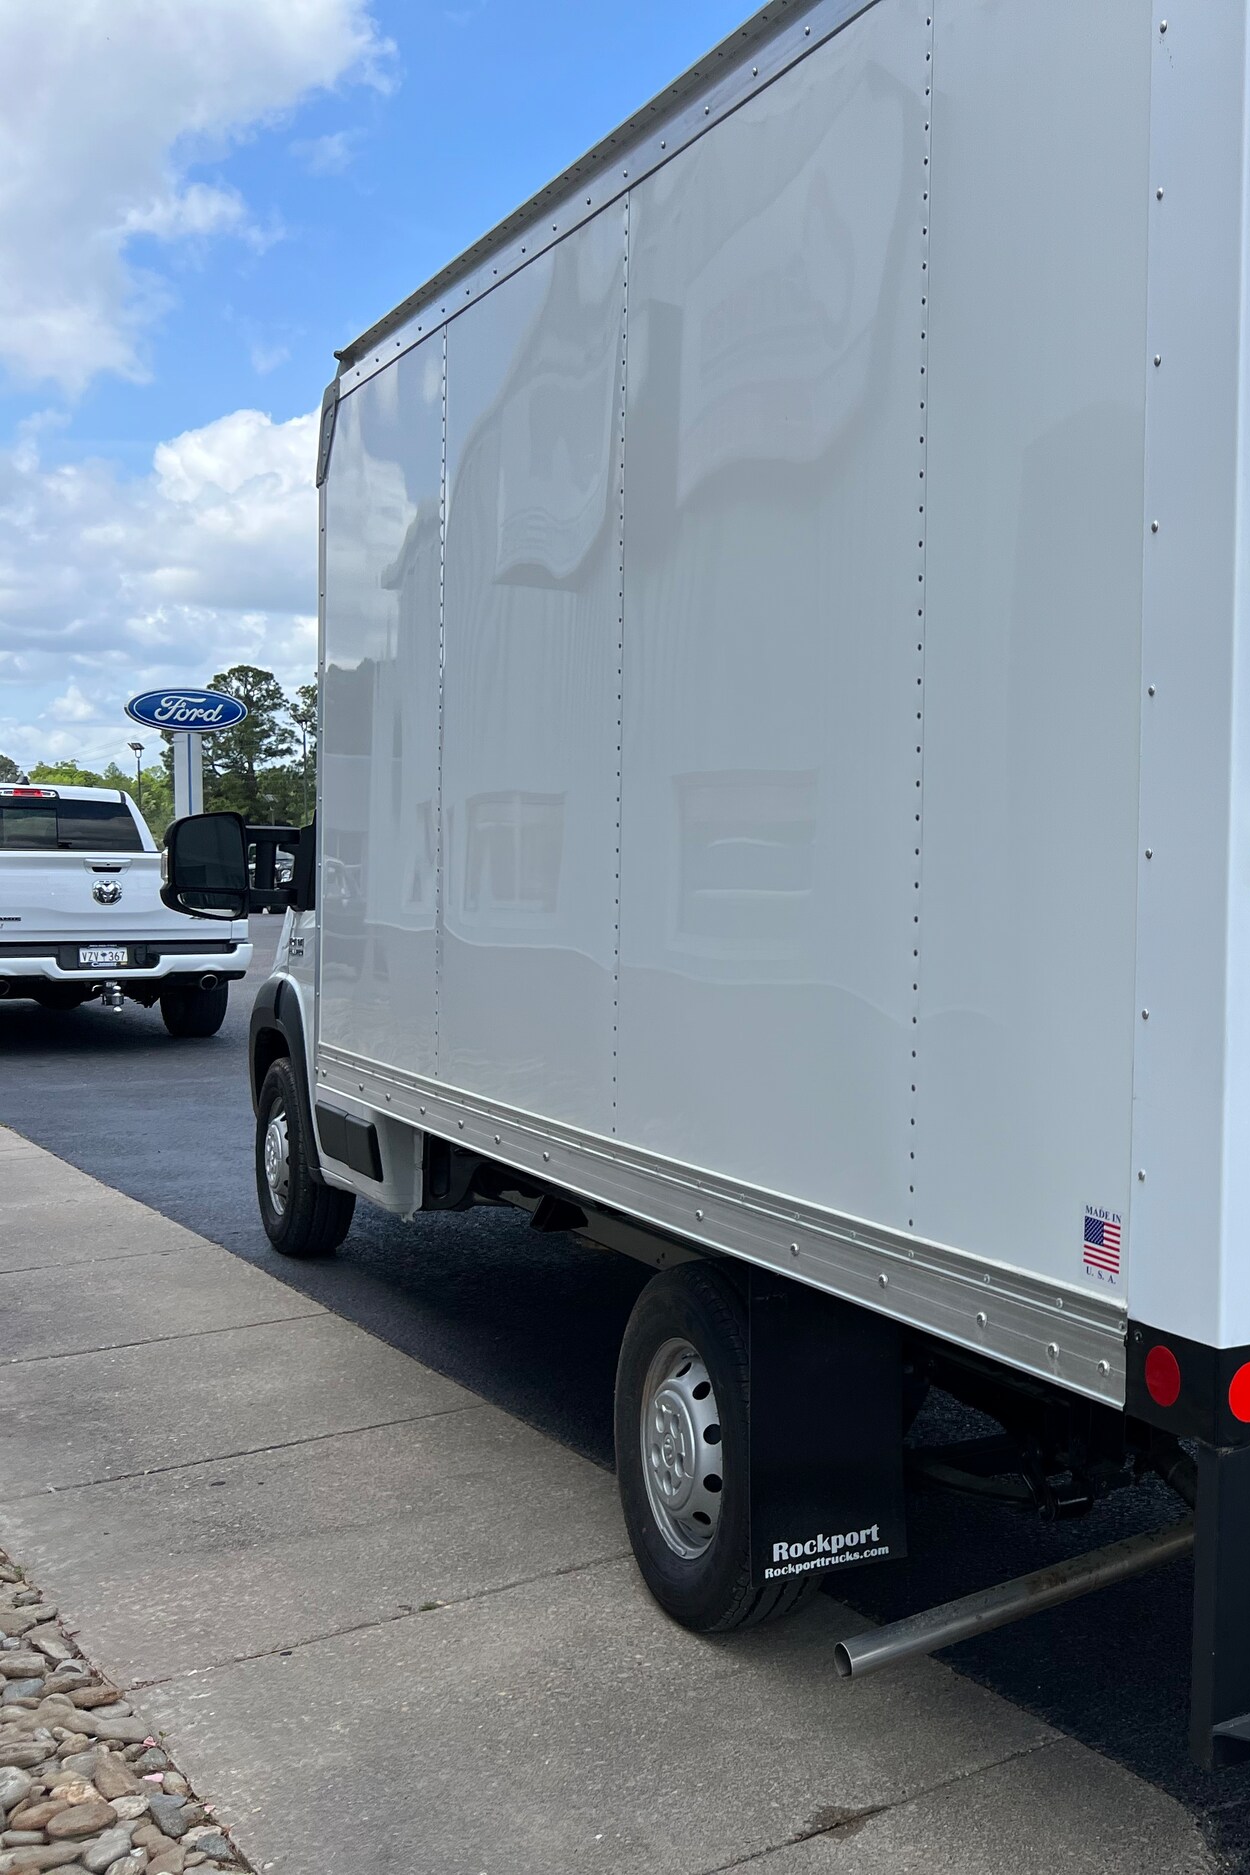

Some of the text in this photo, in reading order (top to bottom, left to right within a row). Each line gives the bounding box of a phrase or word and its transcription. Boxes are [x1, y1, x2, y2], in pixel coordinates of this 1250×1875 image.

[154, 695, 224, 722] Ford
[108, 951, 125, 961] 367
[1085, 1204, 1122, 1224] MADE IN
[772, 1524, 880, 1562] Rockport
[764, 1546, 890, 1579] Rockporttrucks.com
